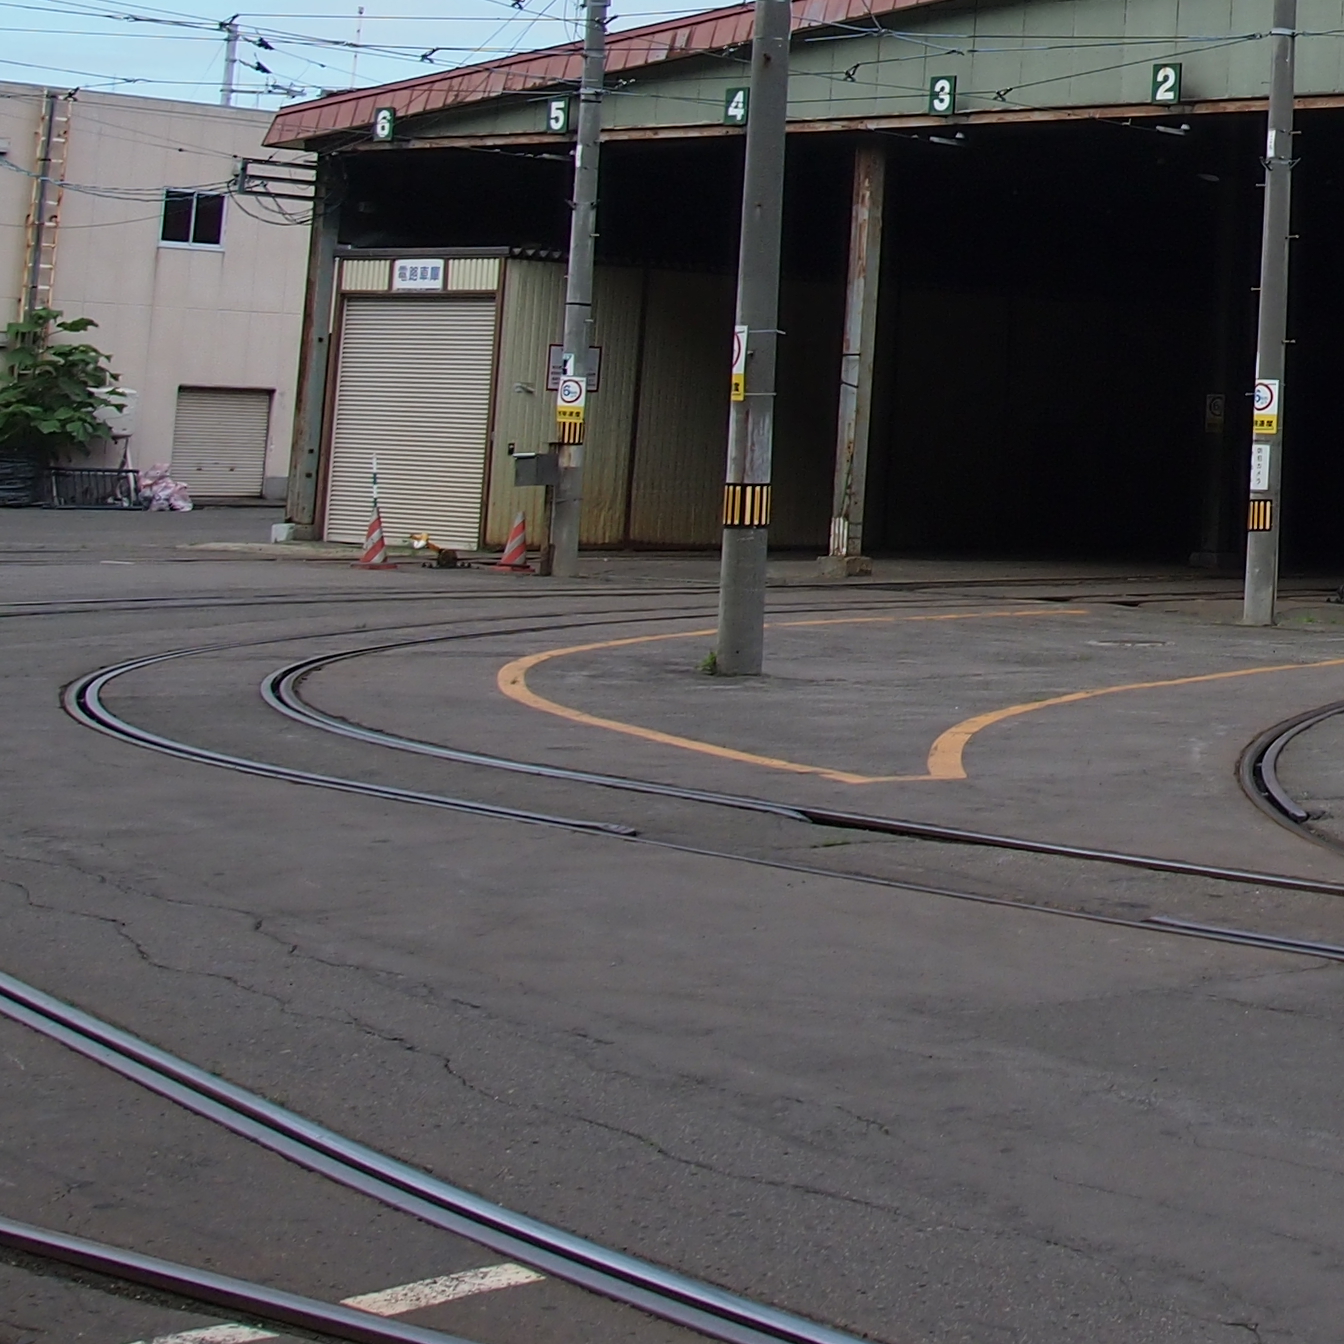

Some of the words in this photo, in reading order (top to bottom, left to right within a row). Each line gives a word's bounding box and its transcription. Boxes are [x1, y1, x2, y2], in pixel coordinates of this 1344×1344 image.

[933, 79, 950, 111] 3
[1155, 67, 1176, 100] 2
[549, 101, 565, 130] 5
[727, 90, 745, 121] 4
[376, 109, 391, 138] 6
[563, 385, 571, 397] 6
